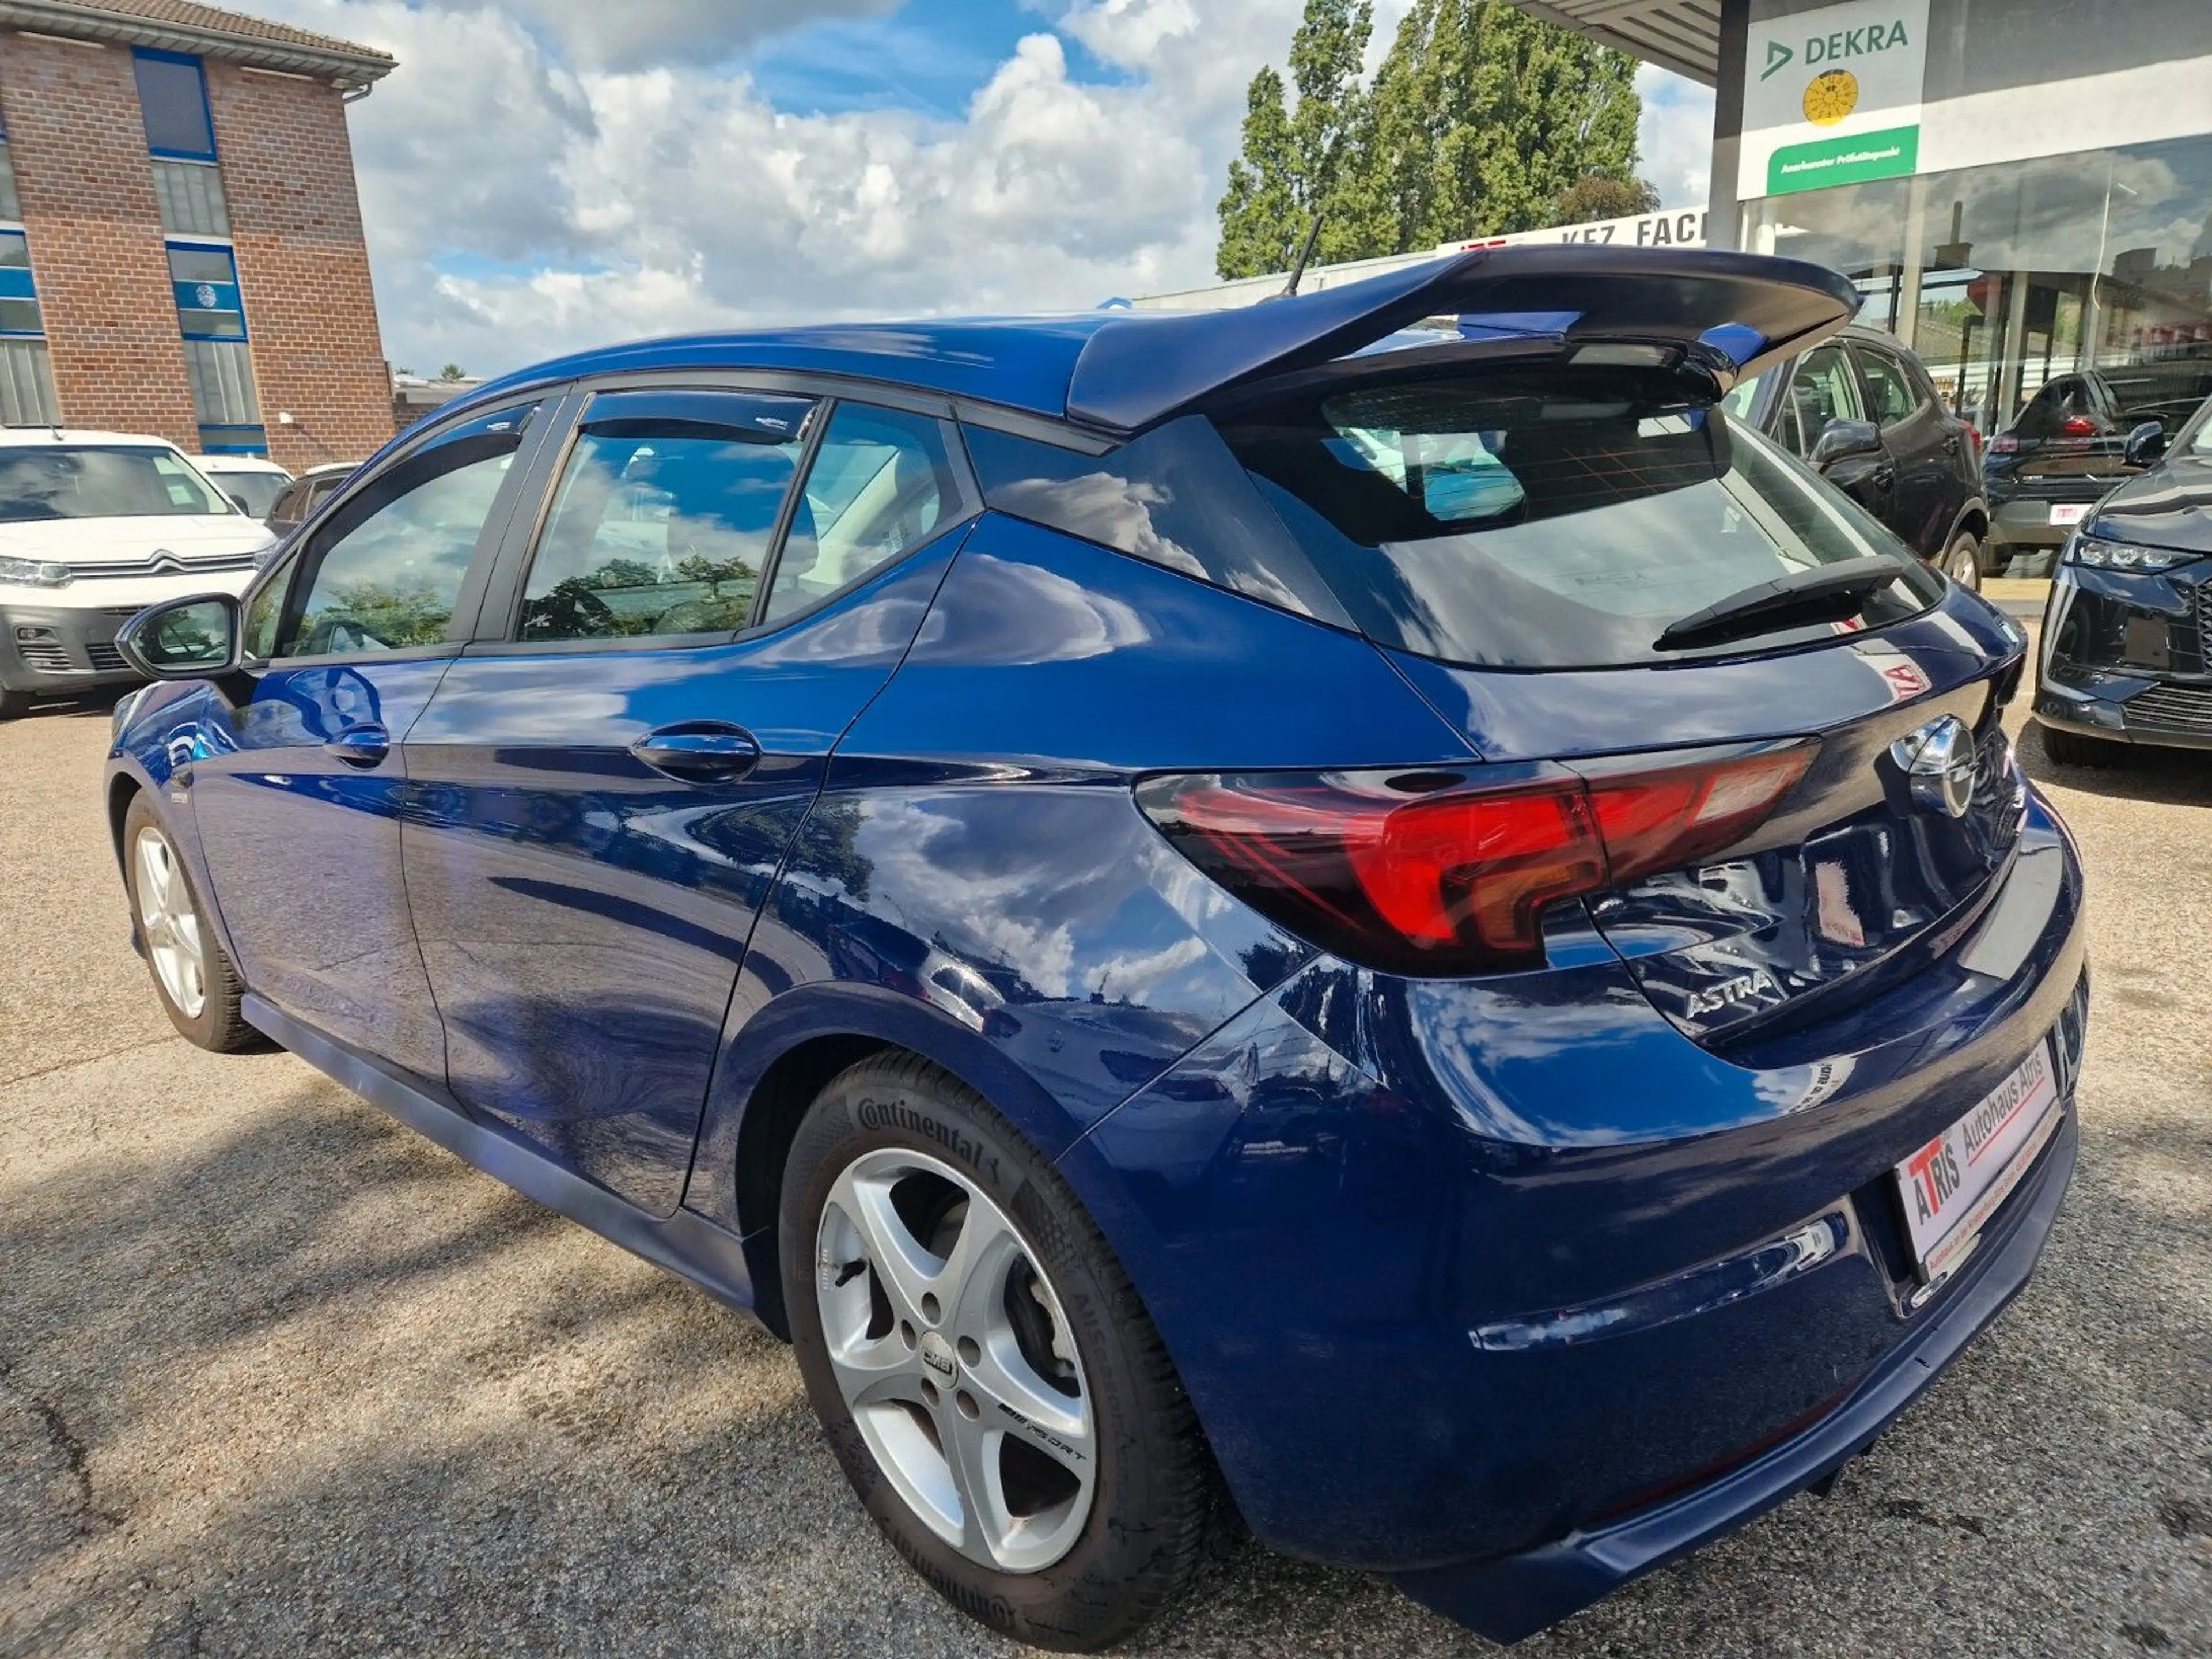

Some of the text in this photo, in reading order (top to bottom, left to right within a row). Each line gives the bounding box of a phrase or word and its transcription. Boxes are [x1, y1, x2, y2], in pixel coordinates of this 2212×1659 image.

[1805, 19, 1908, 65] DEKRA
[1686, 969, 1772, 1019] ASTRA
[857, 1097, 984, 1171] Continental
[1908, 1137, 1960, 1226] ATRIS
[1962, 1081, 2019, 1159] Autohaus
[2019, 1051, 2043, 1094] Atris
